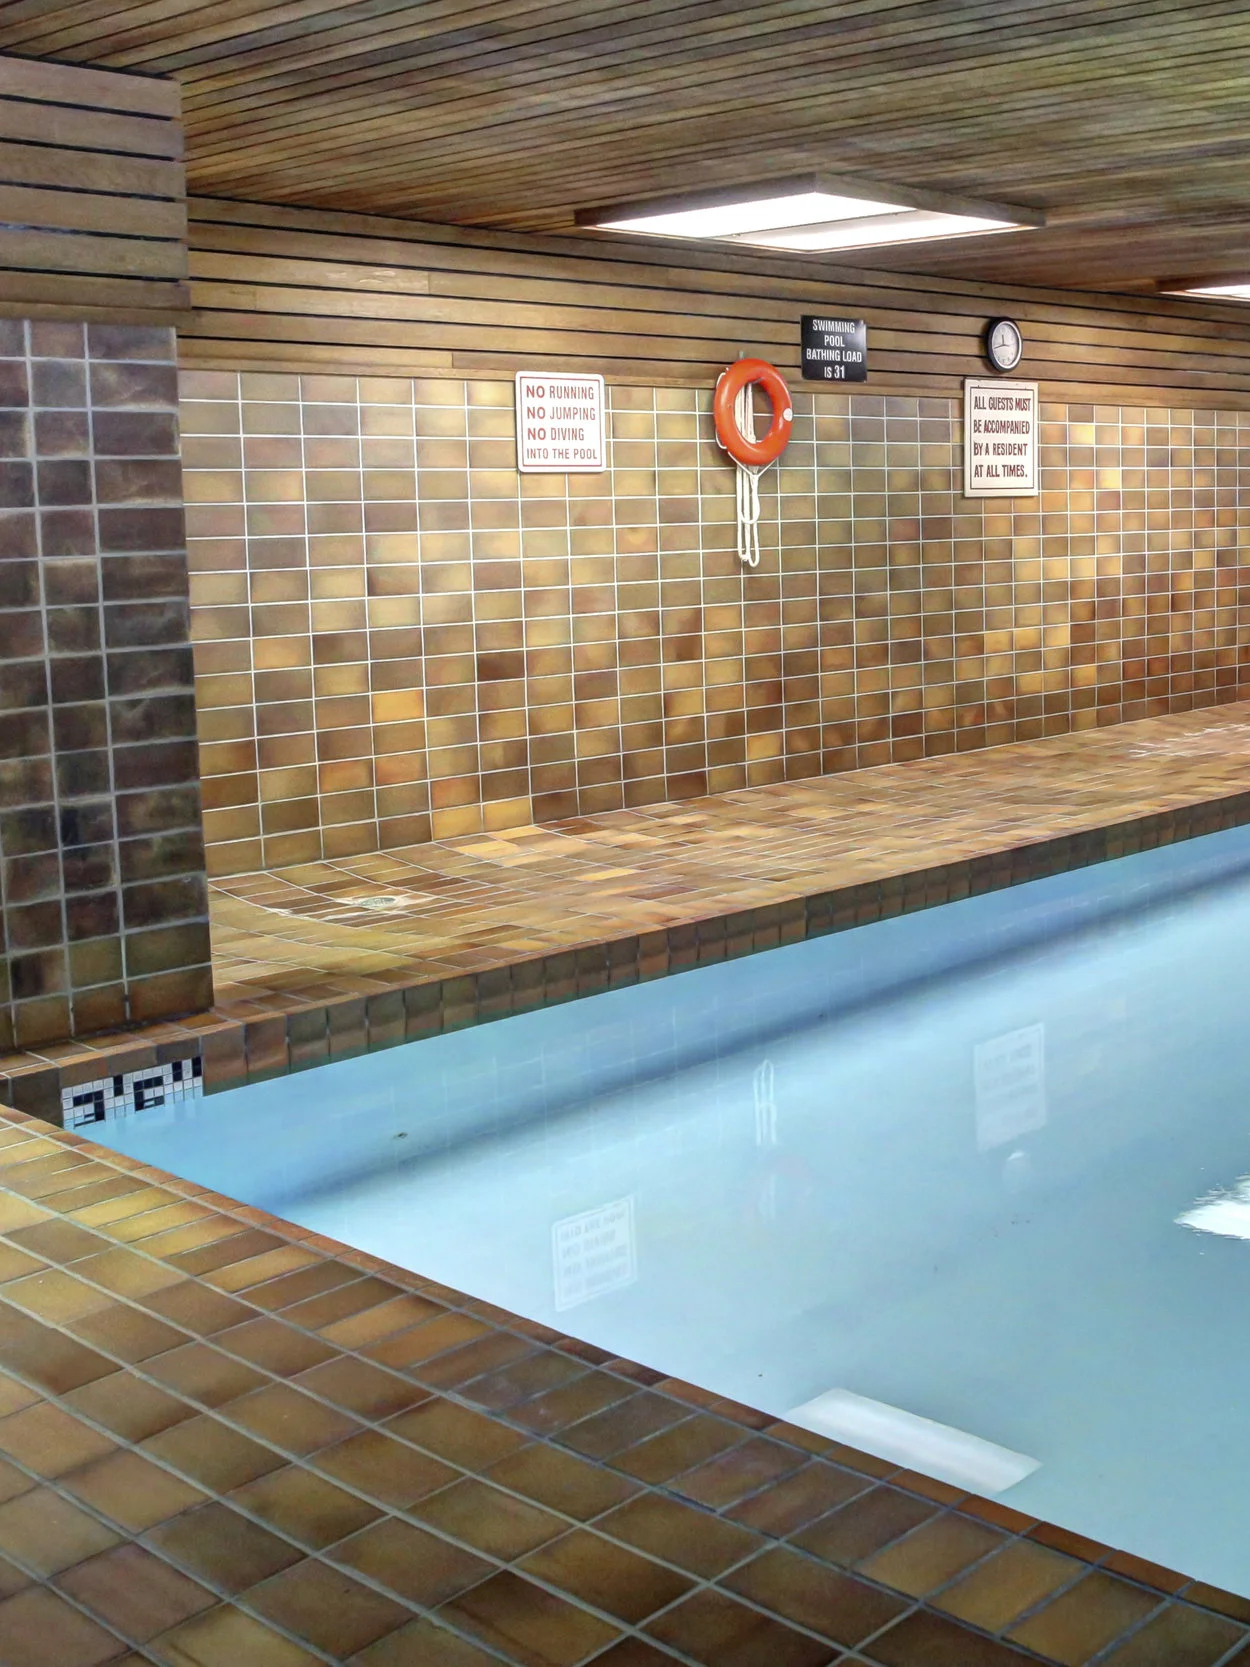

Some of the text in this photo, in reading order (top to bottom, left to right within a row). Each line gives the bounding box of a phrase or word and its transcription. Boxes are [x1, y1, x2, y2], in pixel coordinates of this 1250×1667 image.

[812, 319, 855, 333] SWIMMING
[824, 335, 845, 347] POOL
[806, 348, 862, 362] BATHING LOAD
[824, 365, 845, 378] IS 31
[526, 385, 594, 400] NO RUNNING
[974, 396, 1031, 411] ALL GUESTS MUST
[526, 406, 596, 420] NO JUMPING
[973, 419, 1030, 434] BE ACCOMPANIED
[527, 427, 584, 441] NO DIVING
[526, 448, 597, 460] INTO THE POOL
[973, 442, 1028, 456] BY A RESIDENT
[974, 464, 1028, 478] AT ALL TIMES.
